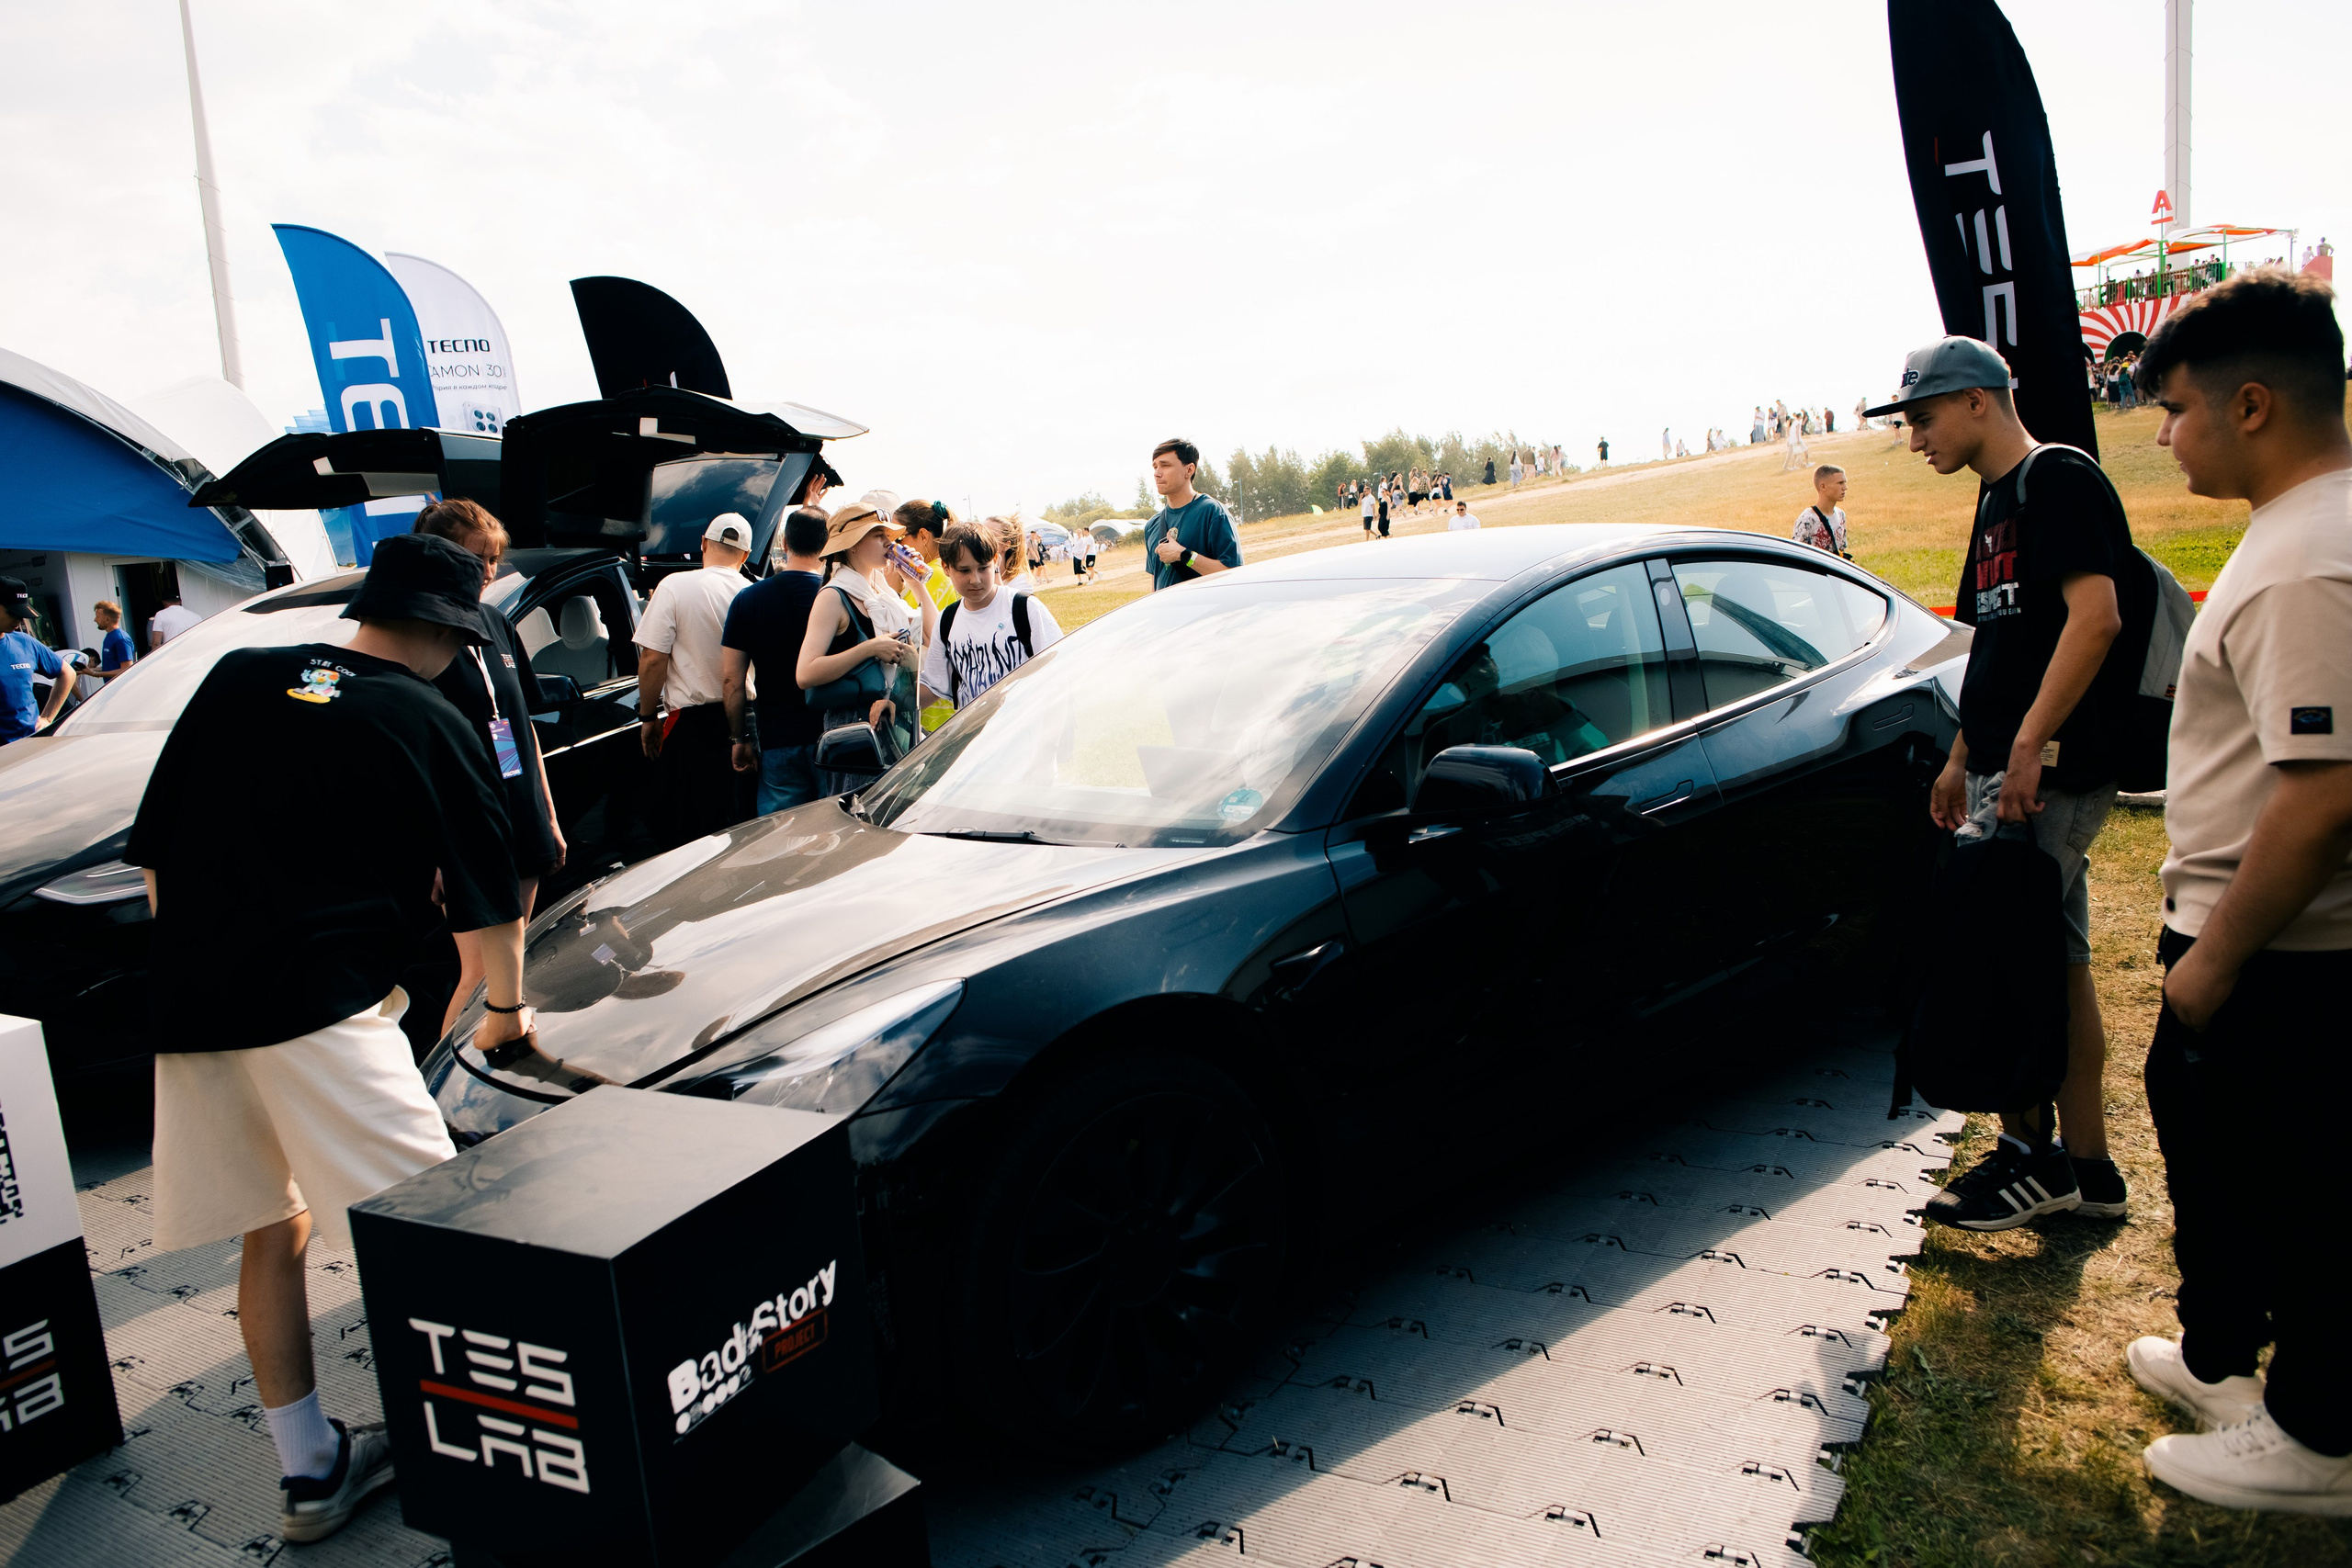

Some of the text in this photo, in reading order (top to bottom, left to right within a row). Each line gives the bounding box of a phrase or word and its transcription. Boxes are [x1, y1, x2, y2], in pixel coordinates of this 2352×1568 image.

[427, 339, 491, 354] TECNO
[310, 659, 332, 667] STAY
[0, 1318, 55, 1371] S
[408, 1317, 576, 1407] TES
[774, 1323, 816, 1360] PROJECT
[423, 1401, 591, 1495] LAB
